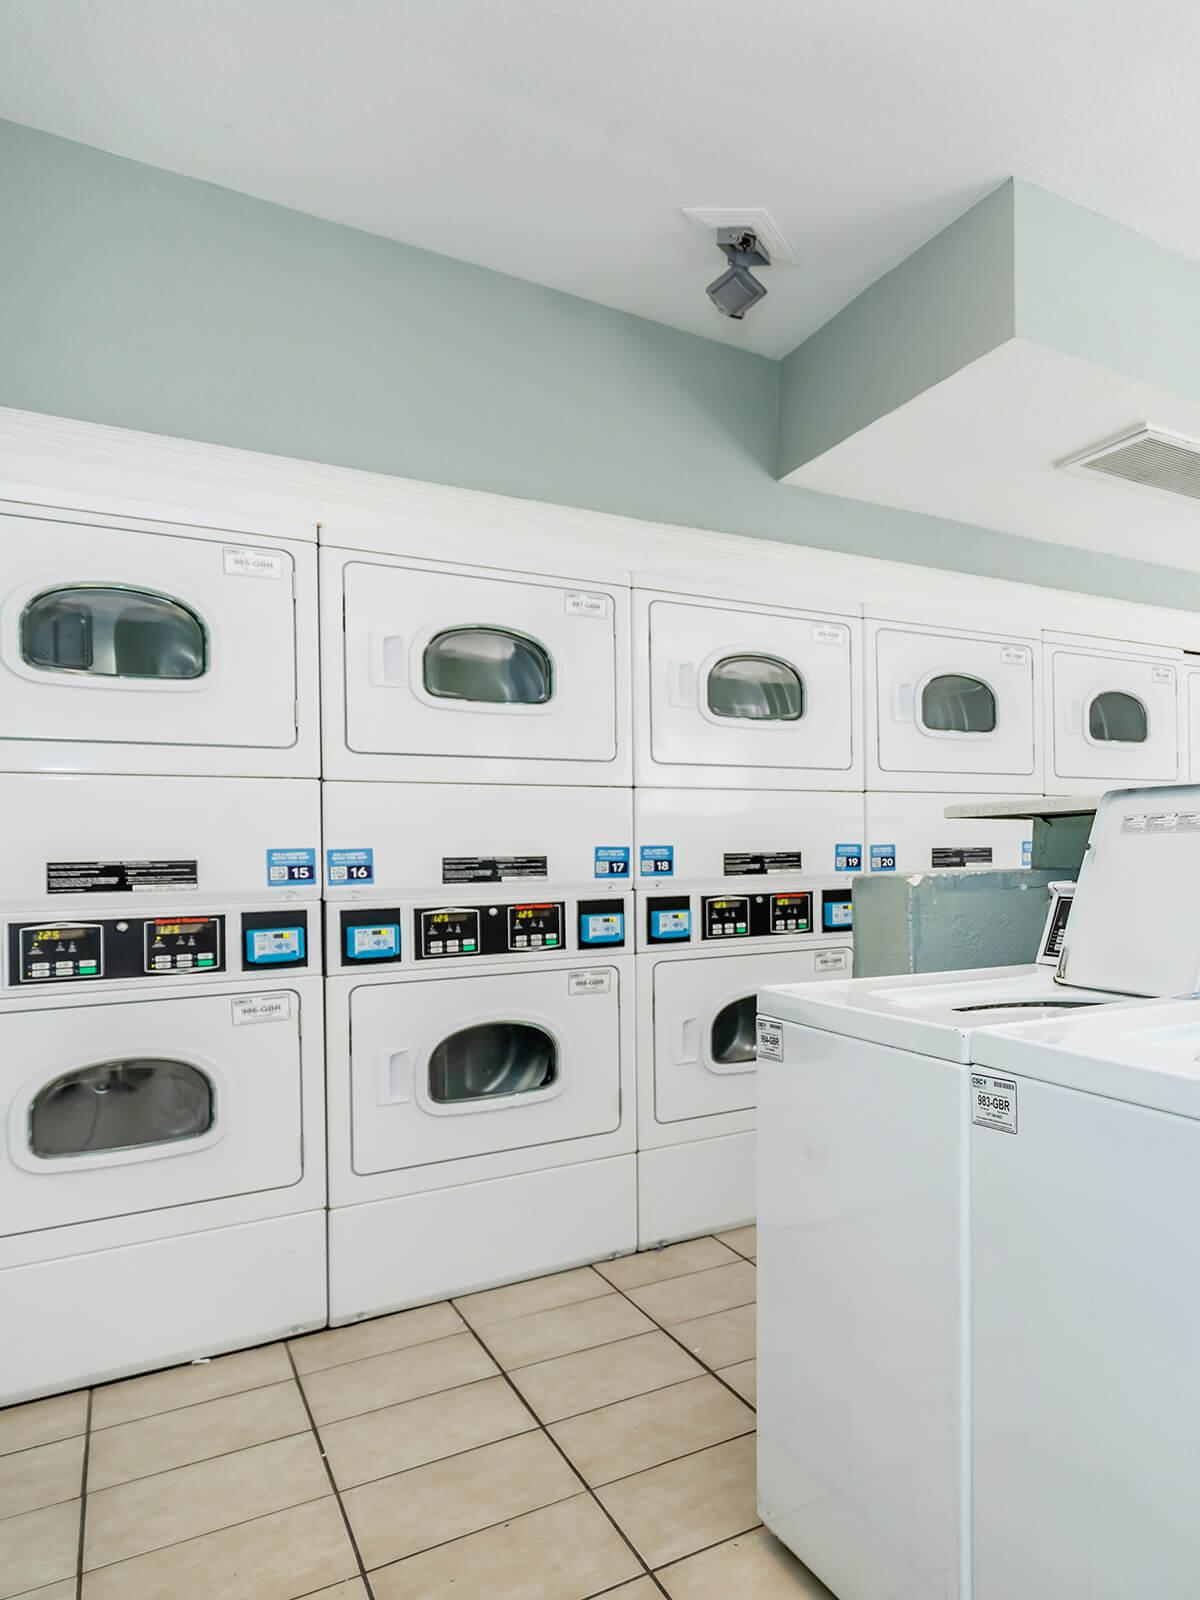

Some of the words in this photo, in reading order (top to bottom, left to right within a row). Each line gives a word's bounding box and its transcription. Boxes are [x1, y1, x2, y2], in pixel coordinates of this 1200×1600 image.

[611, 862, 625, 873] 17
[656, 861, 669, 871] 18
[847, 858, 858, 867] 19
[882, 858, 894, 867] 20
[291, 867, 310, 879] 15
[350, 867, 368, 878] 16
[977, 1094, 1010, 1112] 983-GBR
